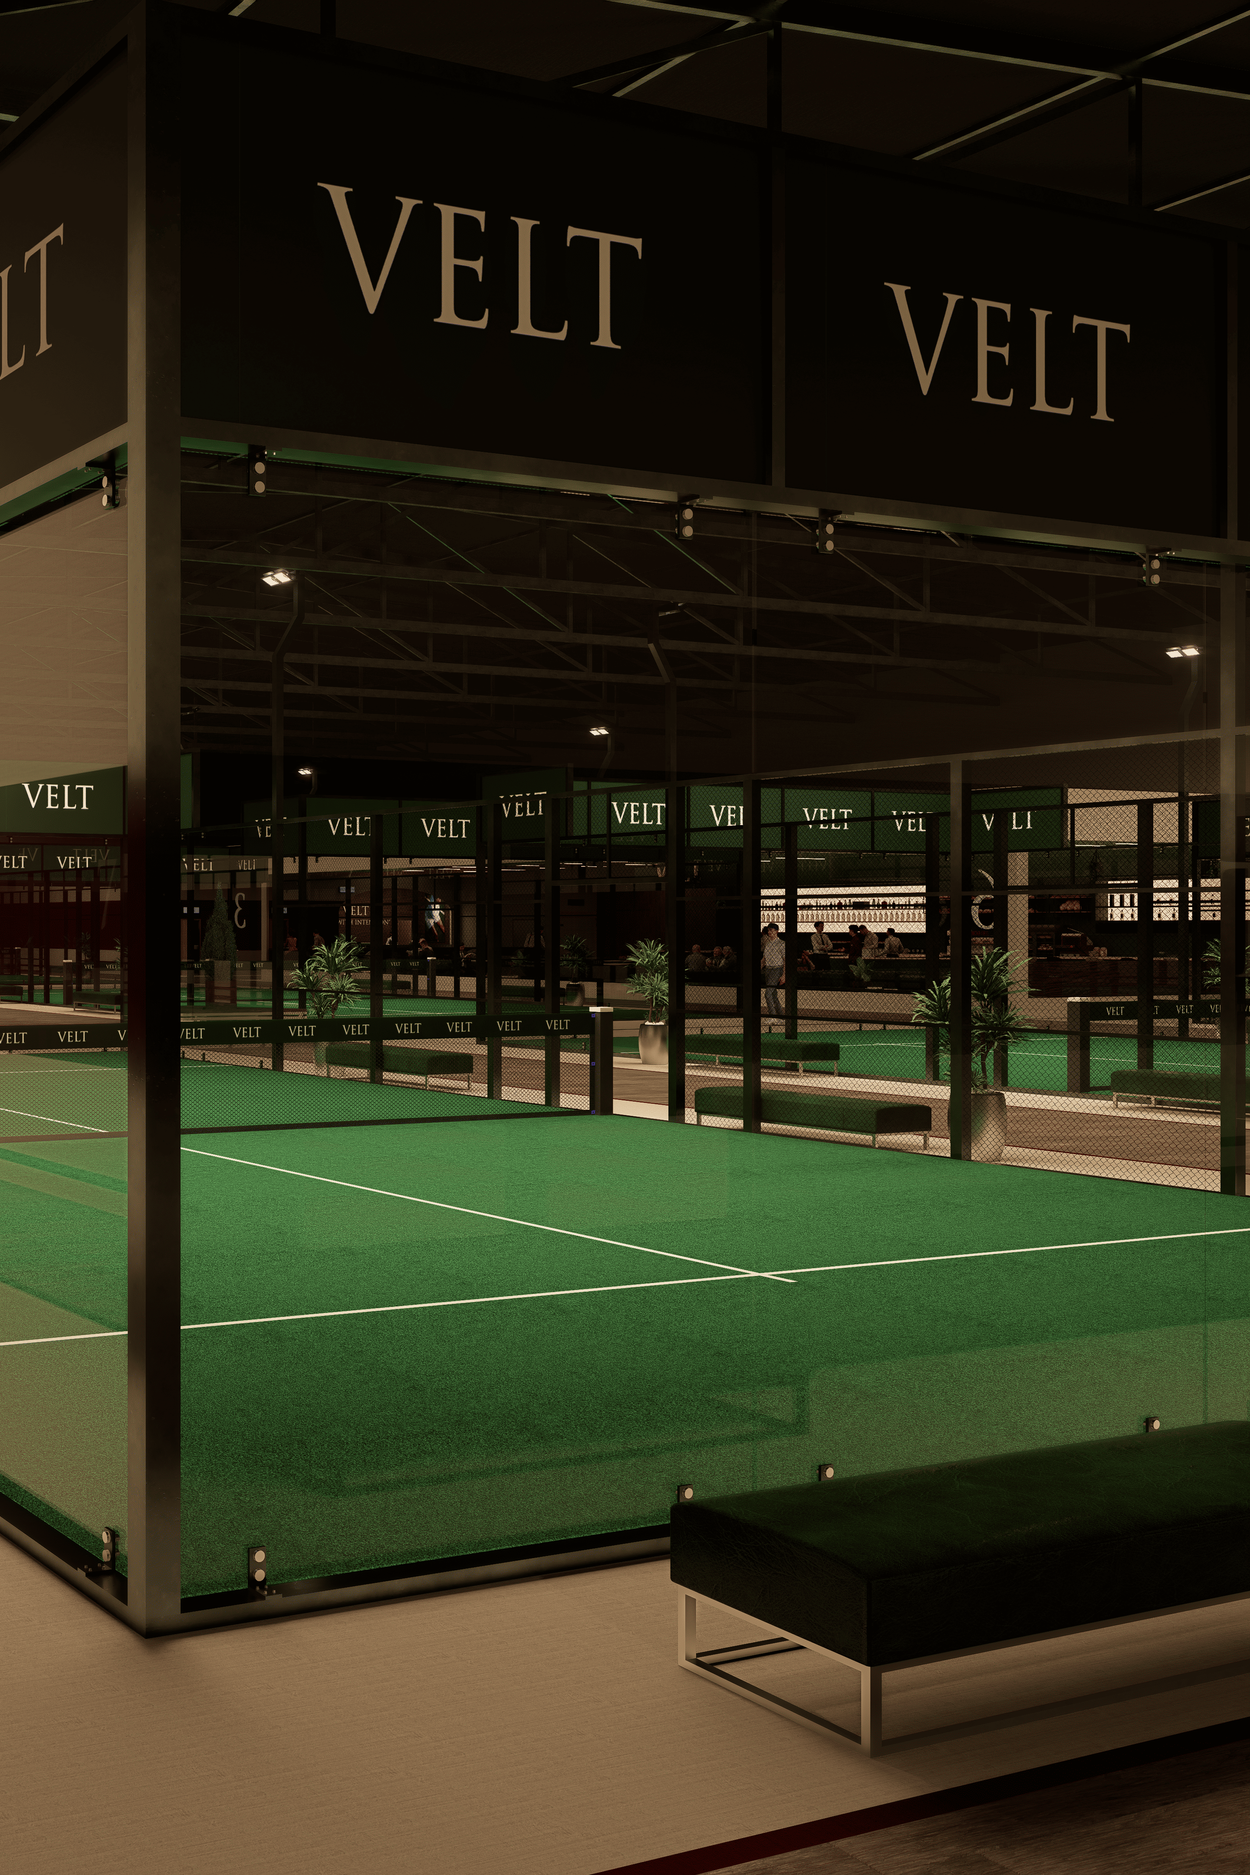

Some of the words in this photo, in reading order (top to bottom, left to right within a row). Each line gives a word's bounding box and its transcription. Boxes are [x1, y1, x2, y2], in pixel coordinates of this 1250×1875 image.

[317, 181, 644, 350] VELT
[883, 281, 1132, 423] VELT
[21, 782, 95, 810] VELT
[499, 790, 548, 818] VELT
[611, 801, 667, 826] VELT
[802, 807, 853, 830] VELT
[891, 810, 934, 832] VEL
[980, 811, 1037, 832] VLT
[421, 817, 472, 839] VELT
[57, 856, 92, 870] VELT
[1105, 1006, 1125, 1016] VELT
[1175, 1004, 1195, 1015] VELT
[1209, 1003, 1221, 1014] VEL
[57, 1030, 89, 1043] VELT
[232, 1026, 262, 1039] VELT
[288, 1025, 317, 1037] VELT
[342, 1023, 371, 1036] VELT
[394, 1022, 422, 1035] VELT
[446, 1021, 473, 1033] VELT
[496, 1020, 523, 1032] VELT
[545, 1018, 571, 1031] VELT
